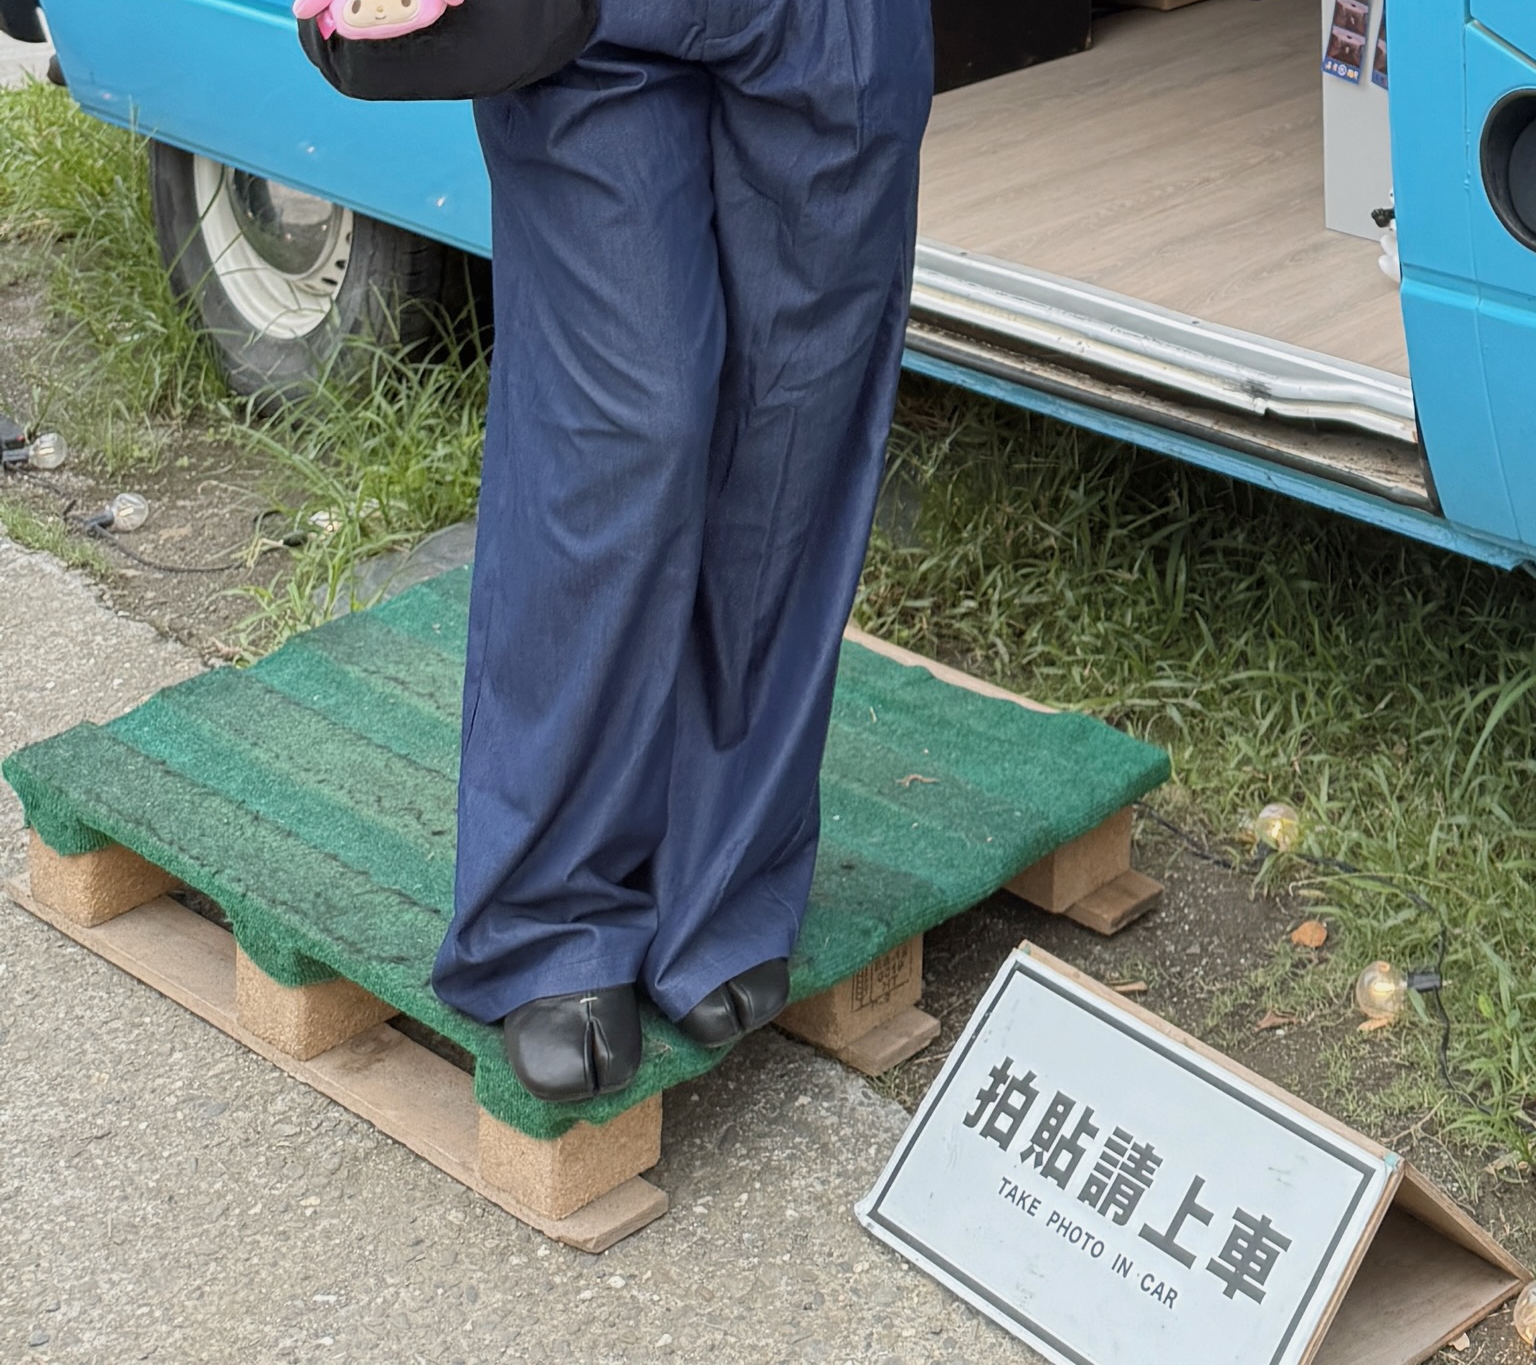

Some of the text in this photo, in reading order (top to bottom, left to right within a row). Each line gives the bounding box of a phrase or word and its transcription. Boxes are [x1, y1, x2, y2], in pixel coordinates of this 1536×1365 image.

[962, 1055, 1293, 1305] 拍貼請上車
[997, 1176, 1179, 1310] TAKE PHOTO IN CAR
